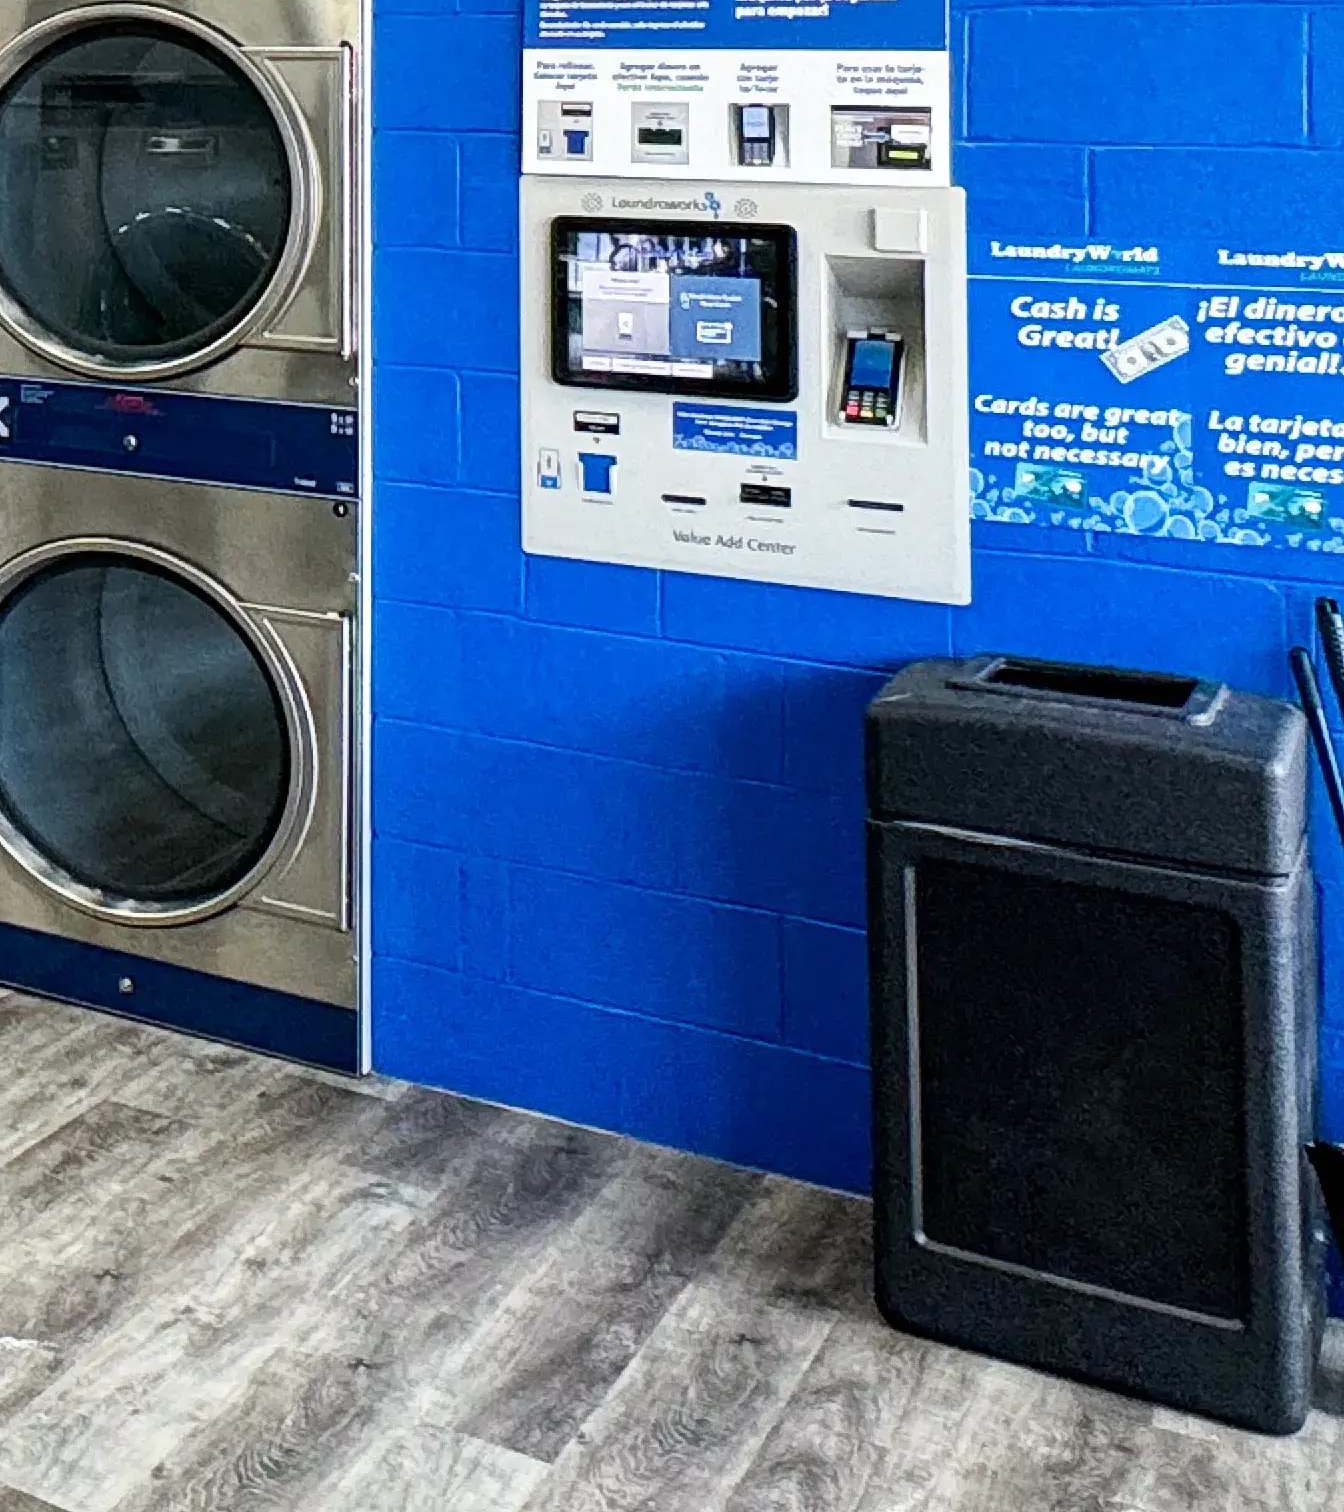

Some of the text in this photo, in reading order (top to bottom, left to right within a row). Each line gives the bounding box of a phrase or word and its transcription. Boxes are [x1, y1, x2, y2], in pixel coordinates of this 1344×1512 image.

[1010, 295, 1120, 322] Cash is
[1196, 295, 1240, 323] ¡El
[1017, 324, 1120, 351] Great!
[1204, 320, 1338, 349] efectivo
[974, 394, 1181, 428] Cards are great
[1208, 409, 1244, 432] La
[1022, 419, 1130, 446] too, but
[1217, 432, 1290, 460] bien,
[983, 440, 1171, 475] not necessary
[1223, 460, 1256, 478] es
[672, 528, 797, 556] Value Add Center
